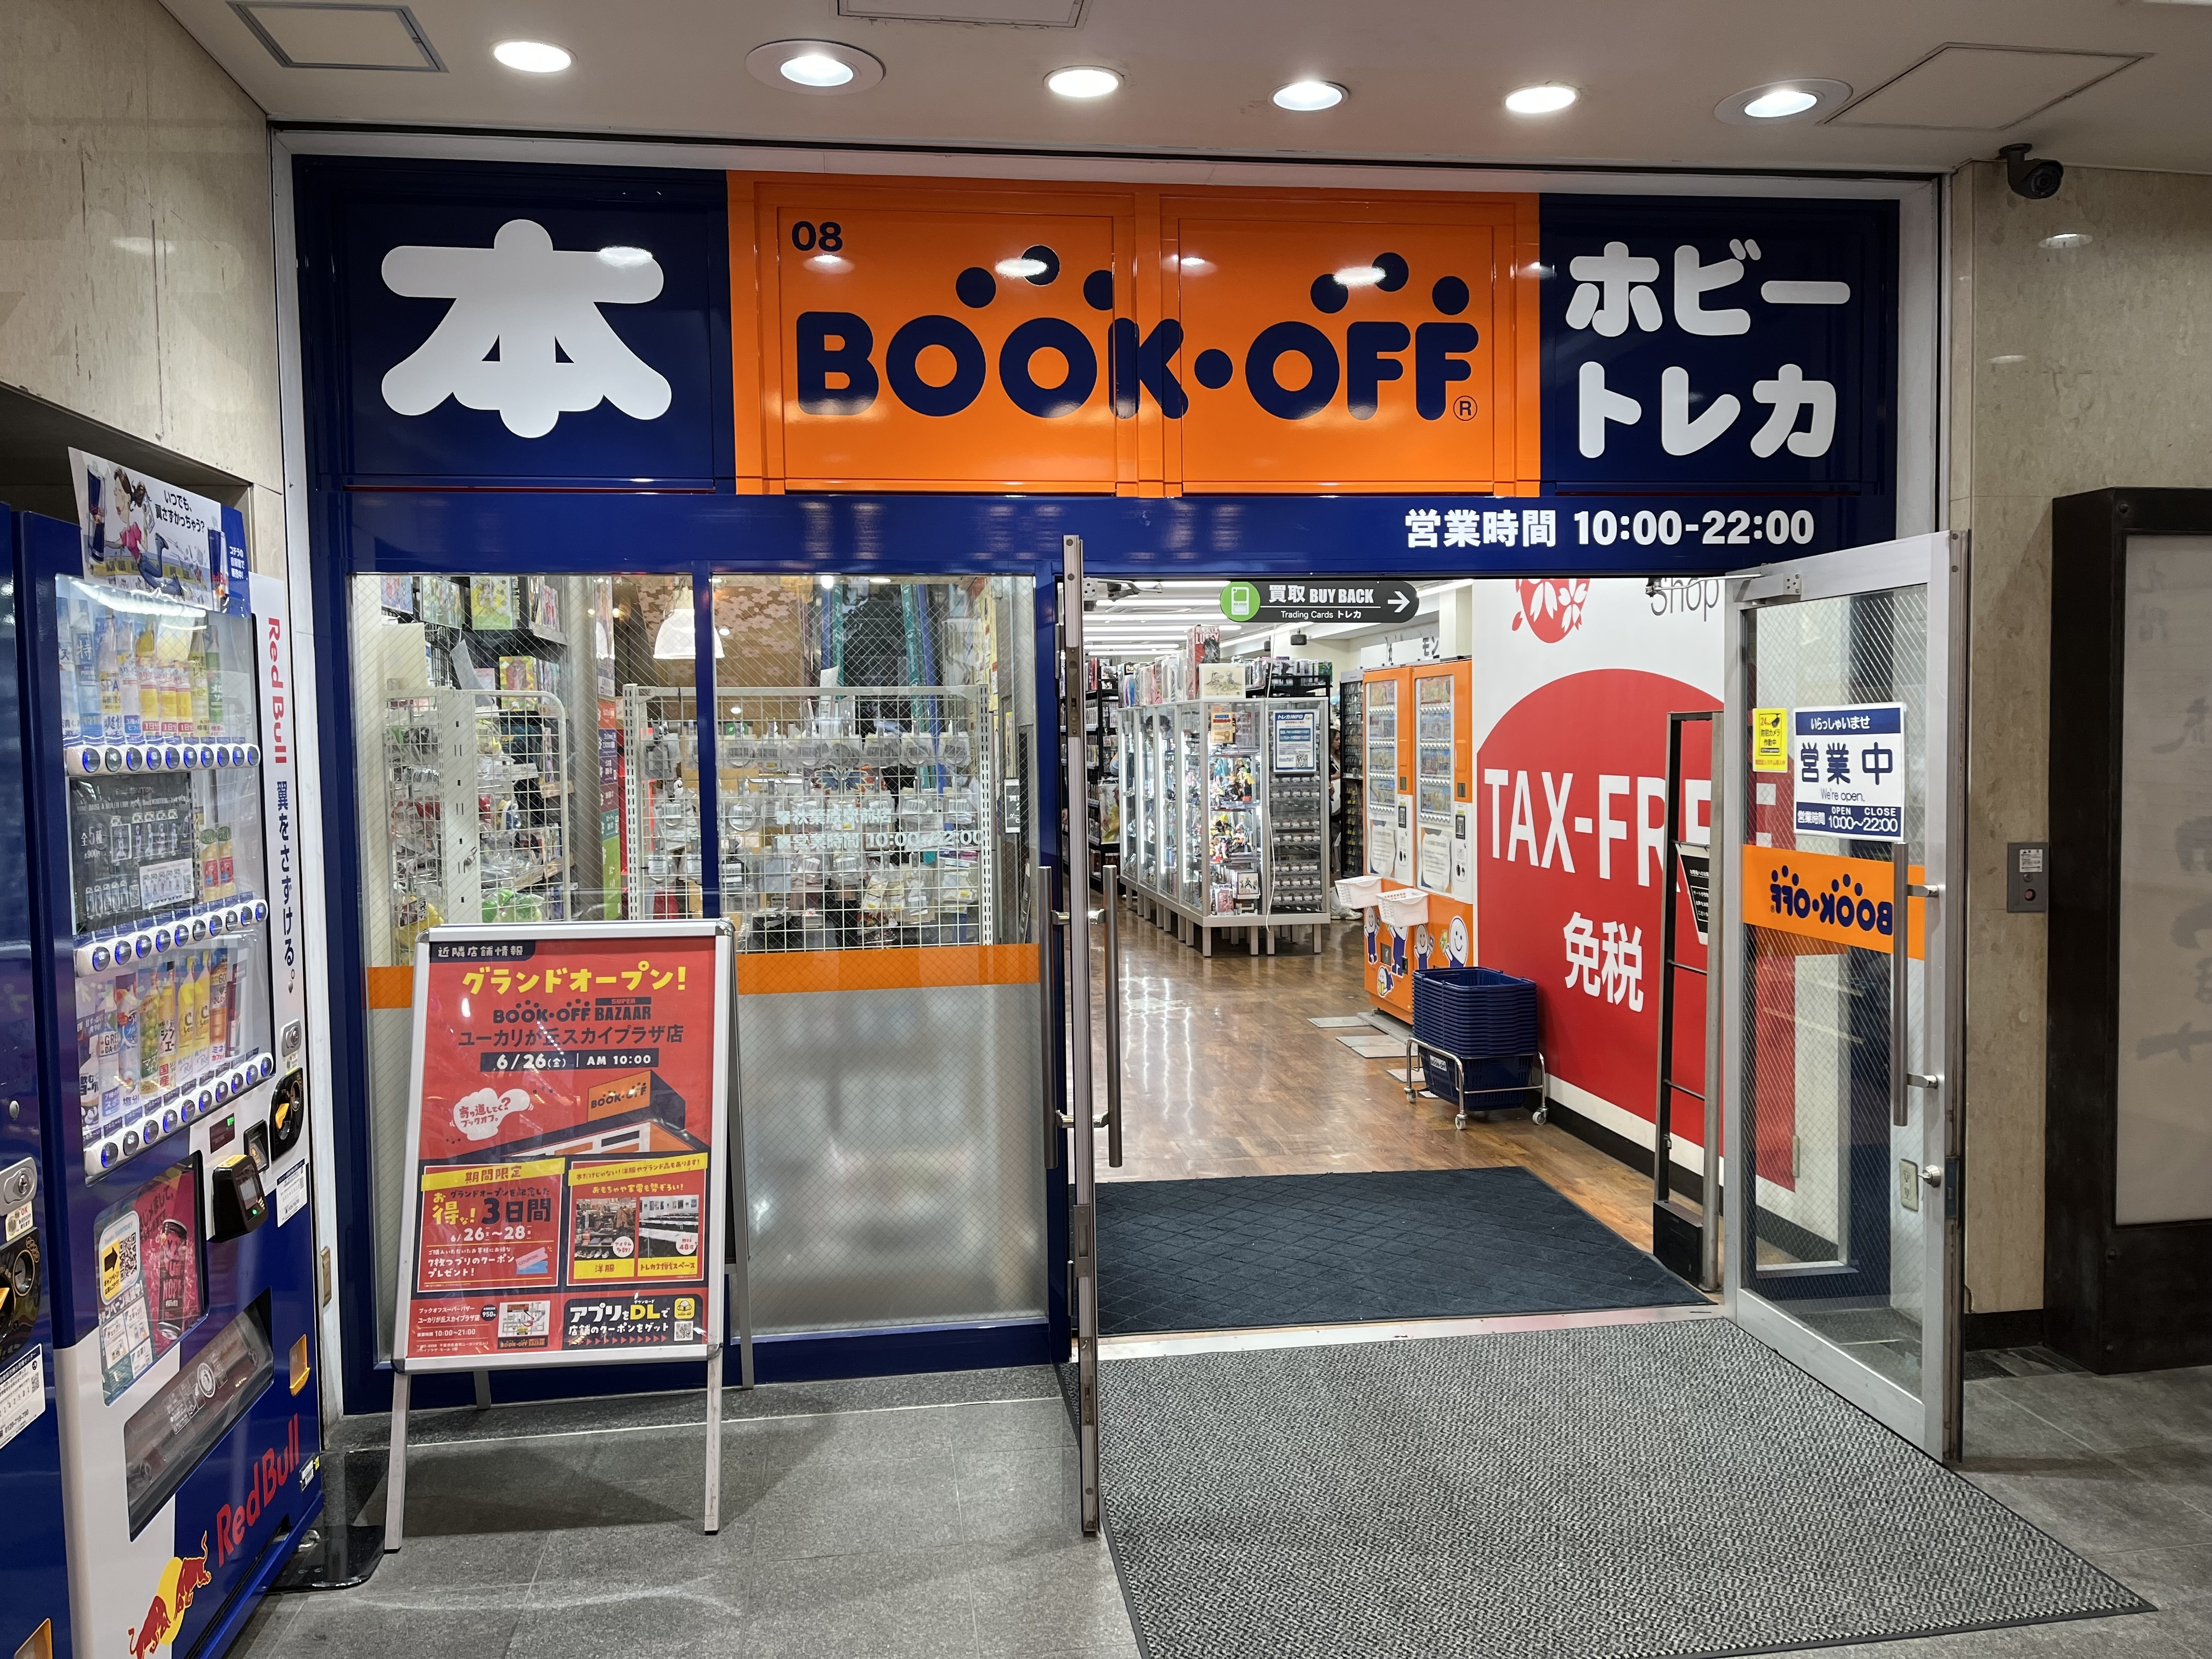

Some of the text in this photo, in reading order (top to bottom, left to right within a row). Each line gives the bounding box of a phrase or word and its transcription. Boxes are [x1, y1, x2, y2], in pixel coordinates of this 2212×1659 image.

[791, 221, 843, 251] 08
[1566, 239, 1851, 337] ホビー
[381, 219, 672, 438] 本
[1578, 361, 1837, 459] トレカ
[1404, 509, 1815, 548] 営業時間 10:00-22:00
[1269, 585, 1374, 603] 買取 BUY BACK
[1280, 611, 1308, 619] Trading
[1338, 610, 1362, 619] トレカ
[268, 617, 287, 763] Red Bull
[1811, 716, 1870, 730] いらっしゃいませ
[1801, 742, 1893, 785] 営業中
[1821, 788, 1865, 802] We're open.
[1797, 810, 1826, 825] 営業時間
[1831, 806, 1897, 817] OPEN CLOSE
[793, 833, 860, 850] 営業時間
[276, 781, 295, 980] 翼をさずける。
[438, 945, 523, 958] 近隣店舗情報
[1564, 911, 1644, 1013] 免税
[462, 960, 686, 995] グランドオープン!
[595, 1006, 652, 1021] BAZAAR
[458, 1024, 684, 1048] ユーカリが丘スカイプラザ店
[586, 1056, 607, 1066] AM
[613, 1054, 652, 1065] 10:00
[159, 1063, 169, 1087] 国産
[459, 1097, 511, 1119] 寄り道してく?
[465, 1165, 522, 1184] 期間限定
[450, 1187, 551, 1199] グランドオープンを記念した
[481, 1197, 551, 1224] 3日間
[427, 1254, 515, 1267] 7枚つづりのクーポン
[518, 1254, 539, 1266] COUPON
[595, 1263, 615, 1273] 洋服
[427, 1267, 475, 1278] プレゼント!
[217, 1413, 300, 1567] Red Bull
